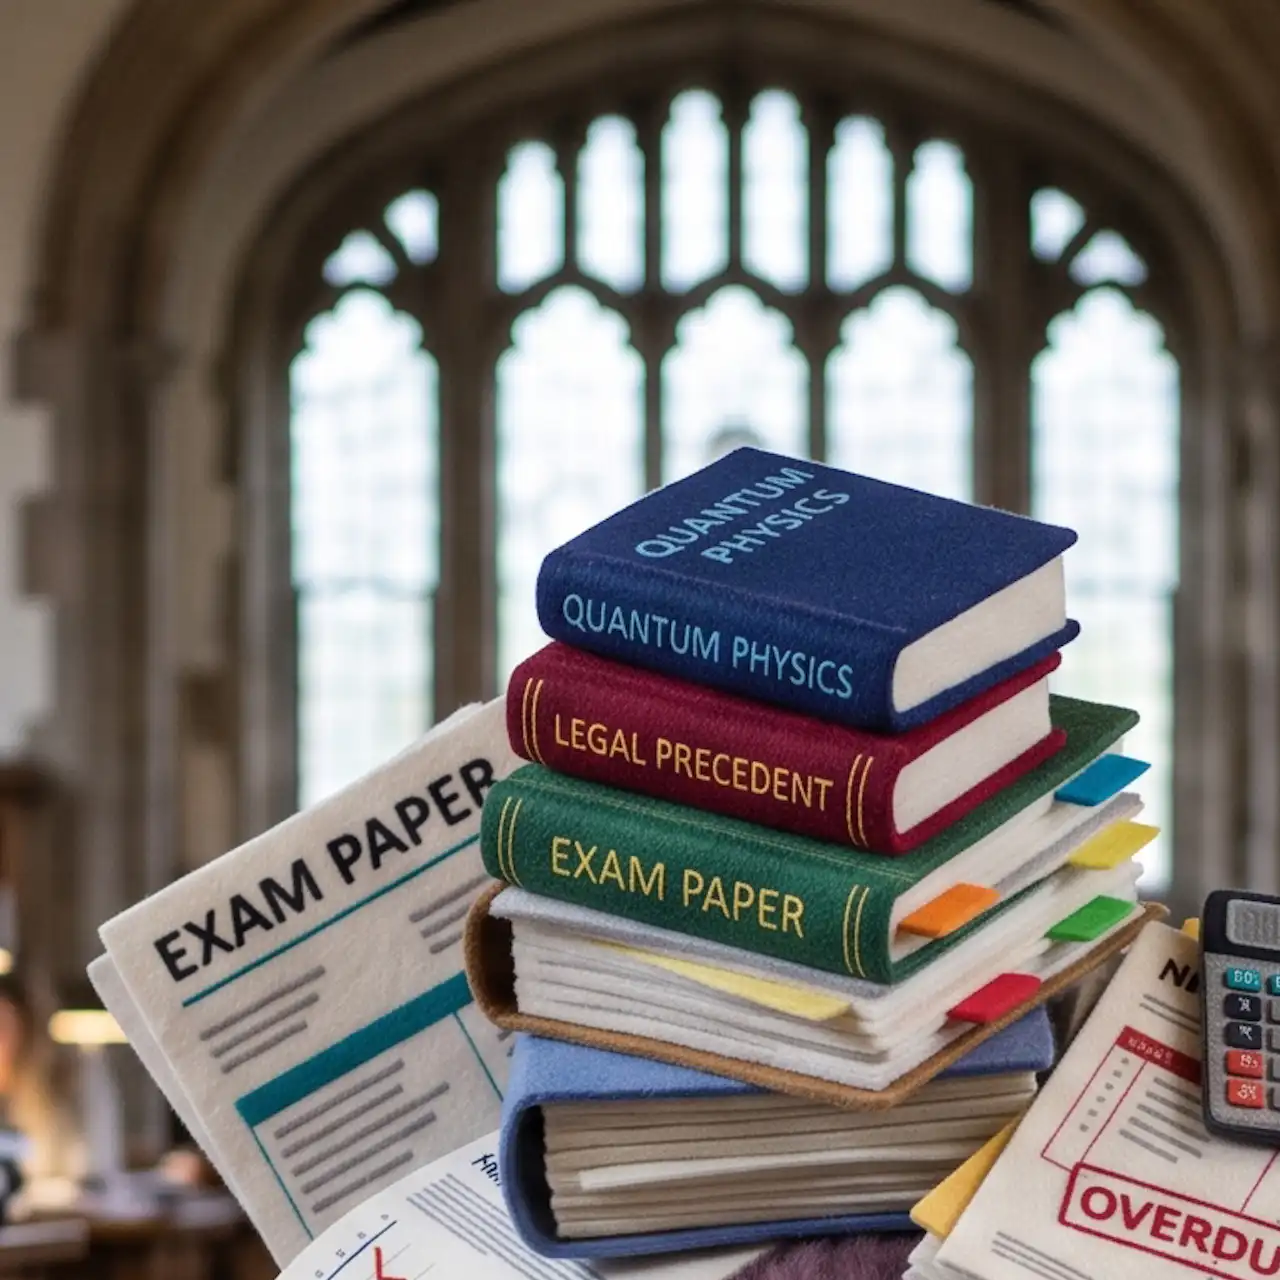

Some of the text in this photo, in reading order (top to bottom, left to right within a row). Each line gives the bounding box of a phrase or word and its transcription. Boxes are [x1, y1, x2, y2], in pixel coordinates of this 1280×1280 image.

[635, 466, 815, 559] QUANTUM
[699, 488, 851, 565] PHYSICS
[562, 593, 854, 699] QUANTUM PHYSICS
[554, 713, 834, 811] LEGAL PRECEDENT
[153, 757, 497, 983] EXAM PAPER
[551, 837, 805, 937] EXAM PAPER
